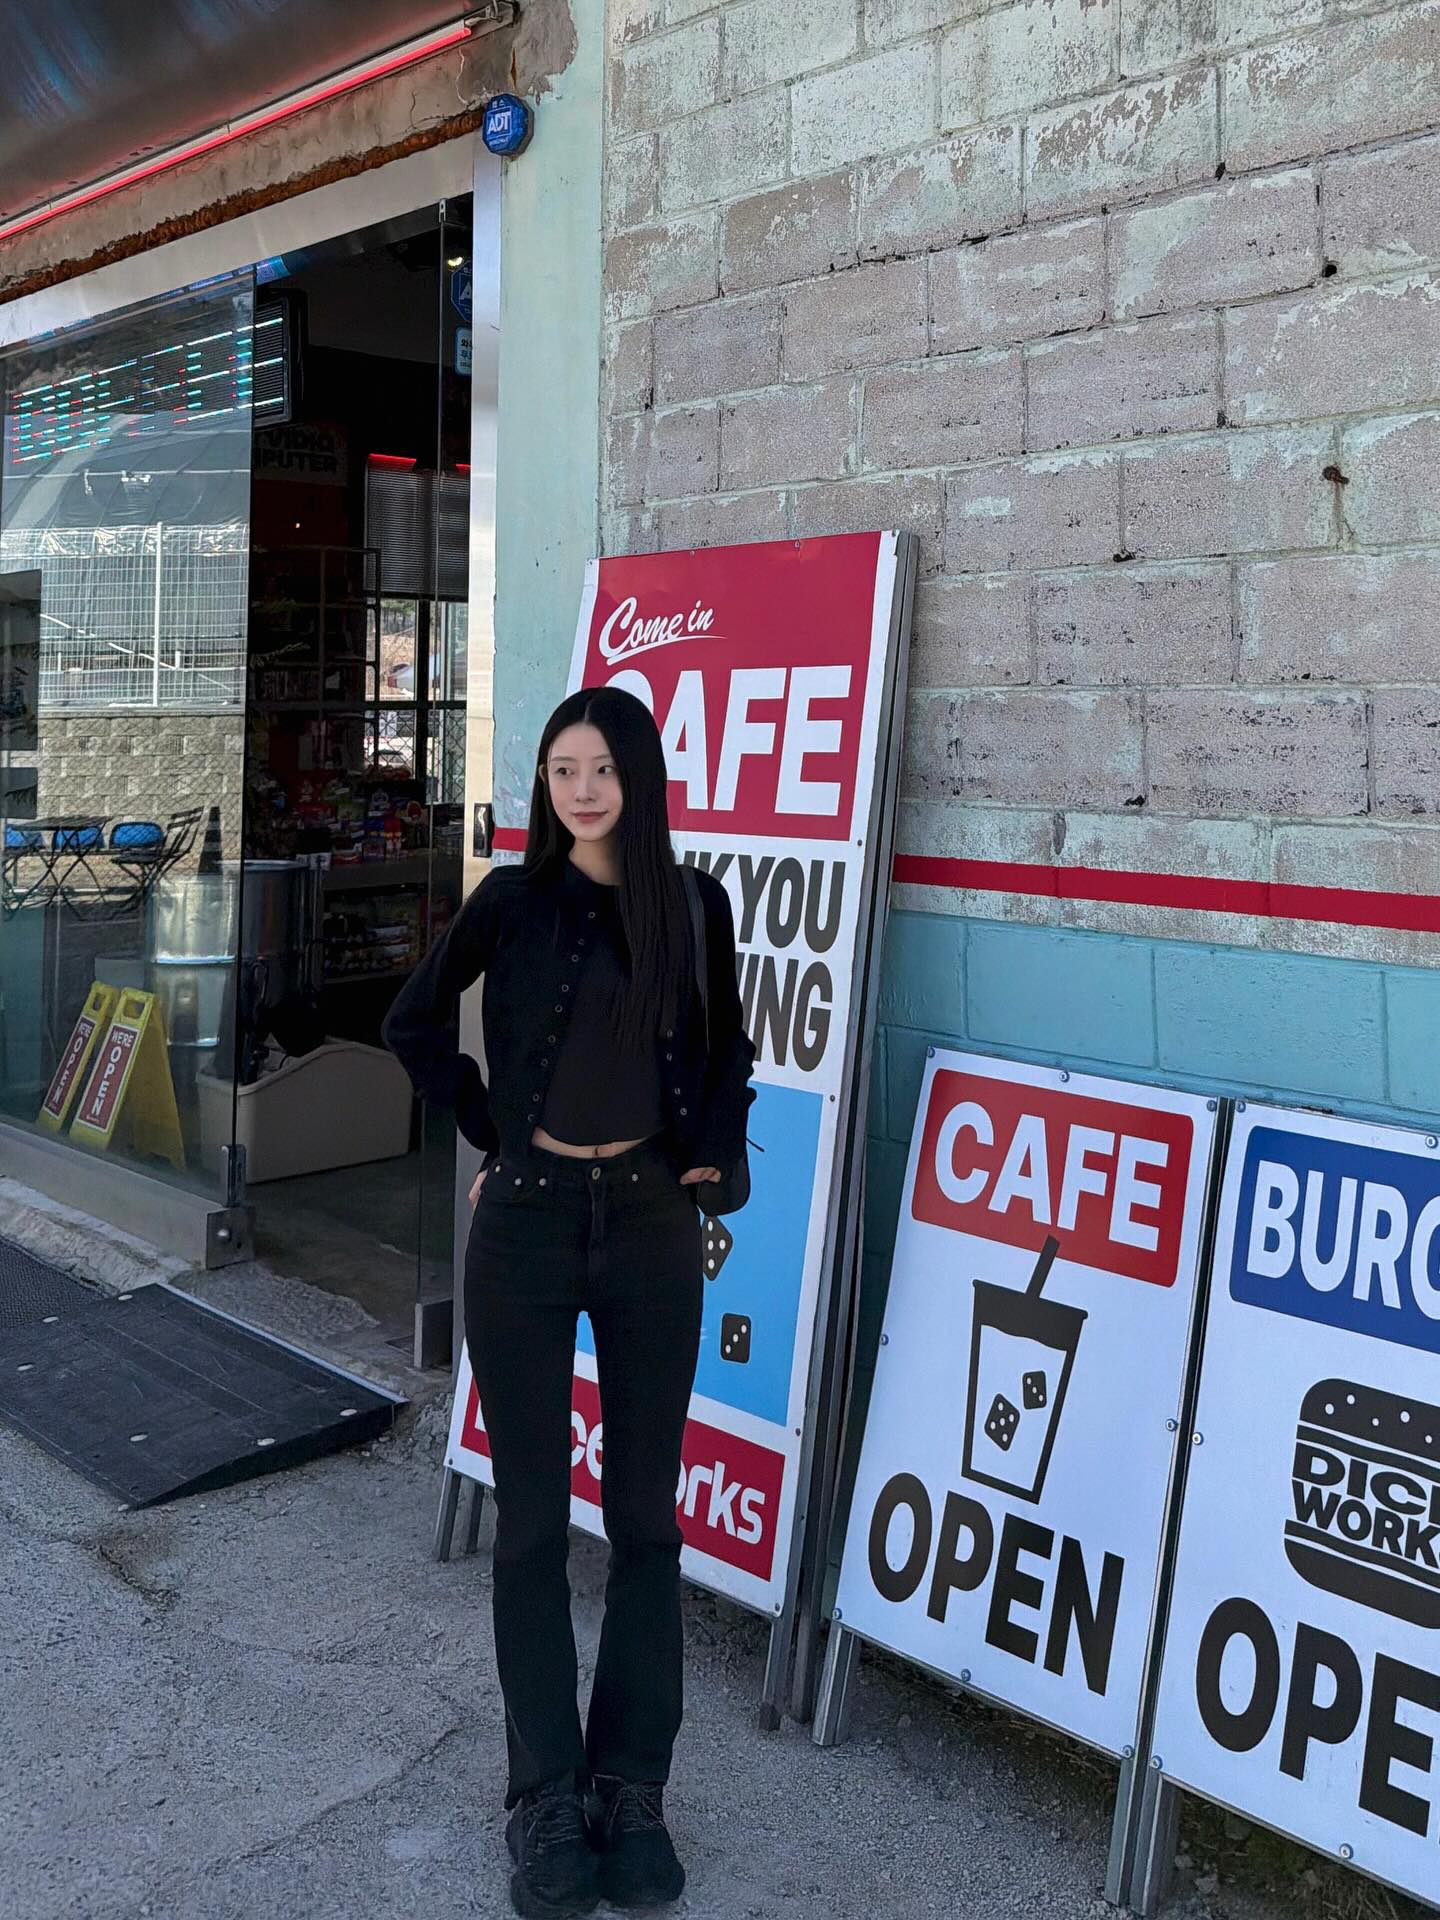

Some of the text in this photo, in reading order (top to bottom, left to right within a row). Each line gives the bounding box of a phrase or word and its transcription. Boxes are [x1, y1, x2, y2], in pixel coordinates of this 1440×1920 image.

[487, 112, 511, 134] ADT
[598, 597, 715, 660] Come in
[736, 952, 833, 1072] ING
[52, 1036, 84, 1104] OPEN
[92, 1046, 122, 1117] OPEN
[934, 1101, 1168, 1253] CAFE
[1292, 1441, 1440, 1527] DIC
[1292, 1479, 1440, 1570] WORK
[867, 1472, 1126, 1697] OPEN
[1196, 1596, 1440, 1844] OPE
